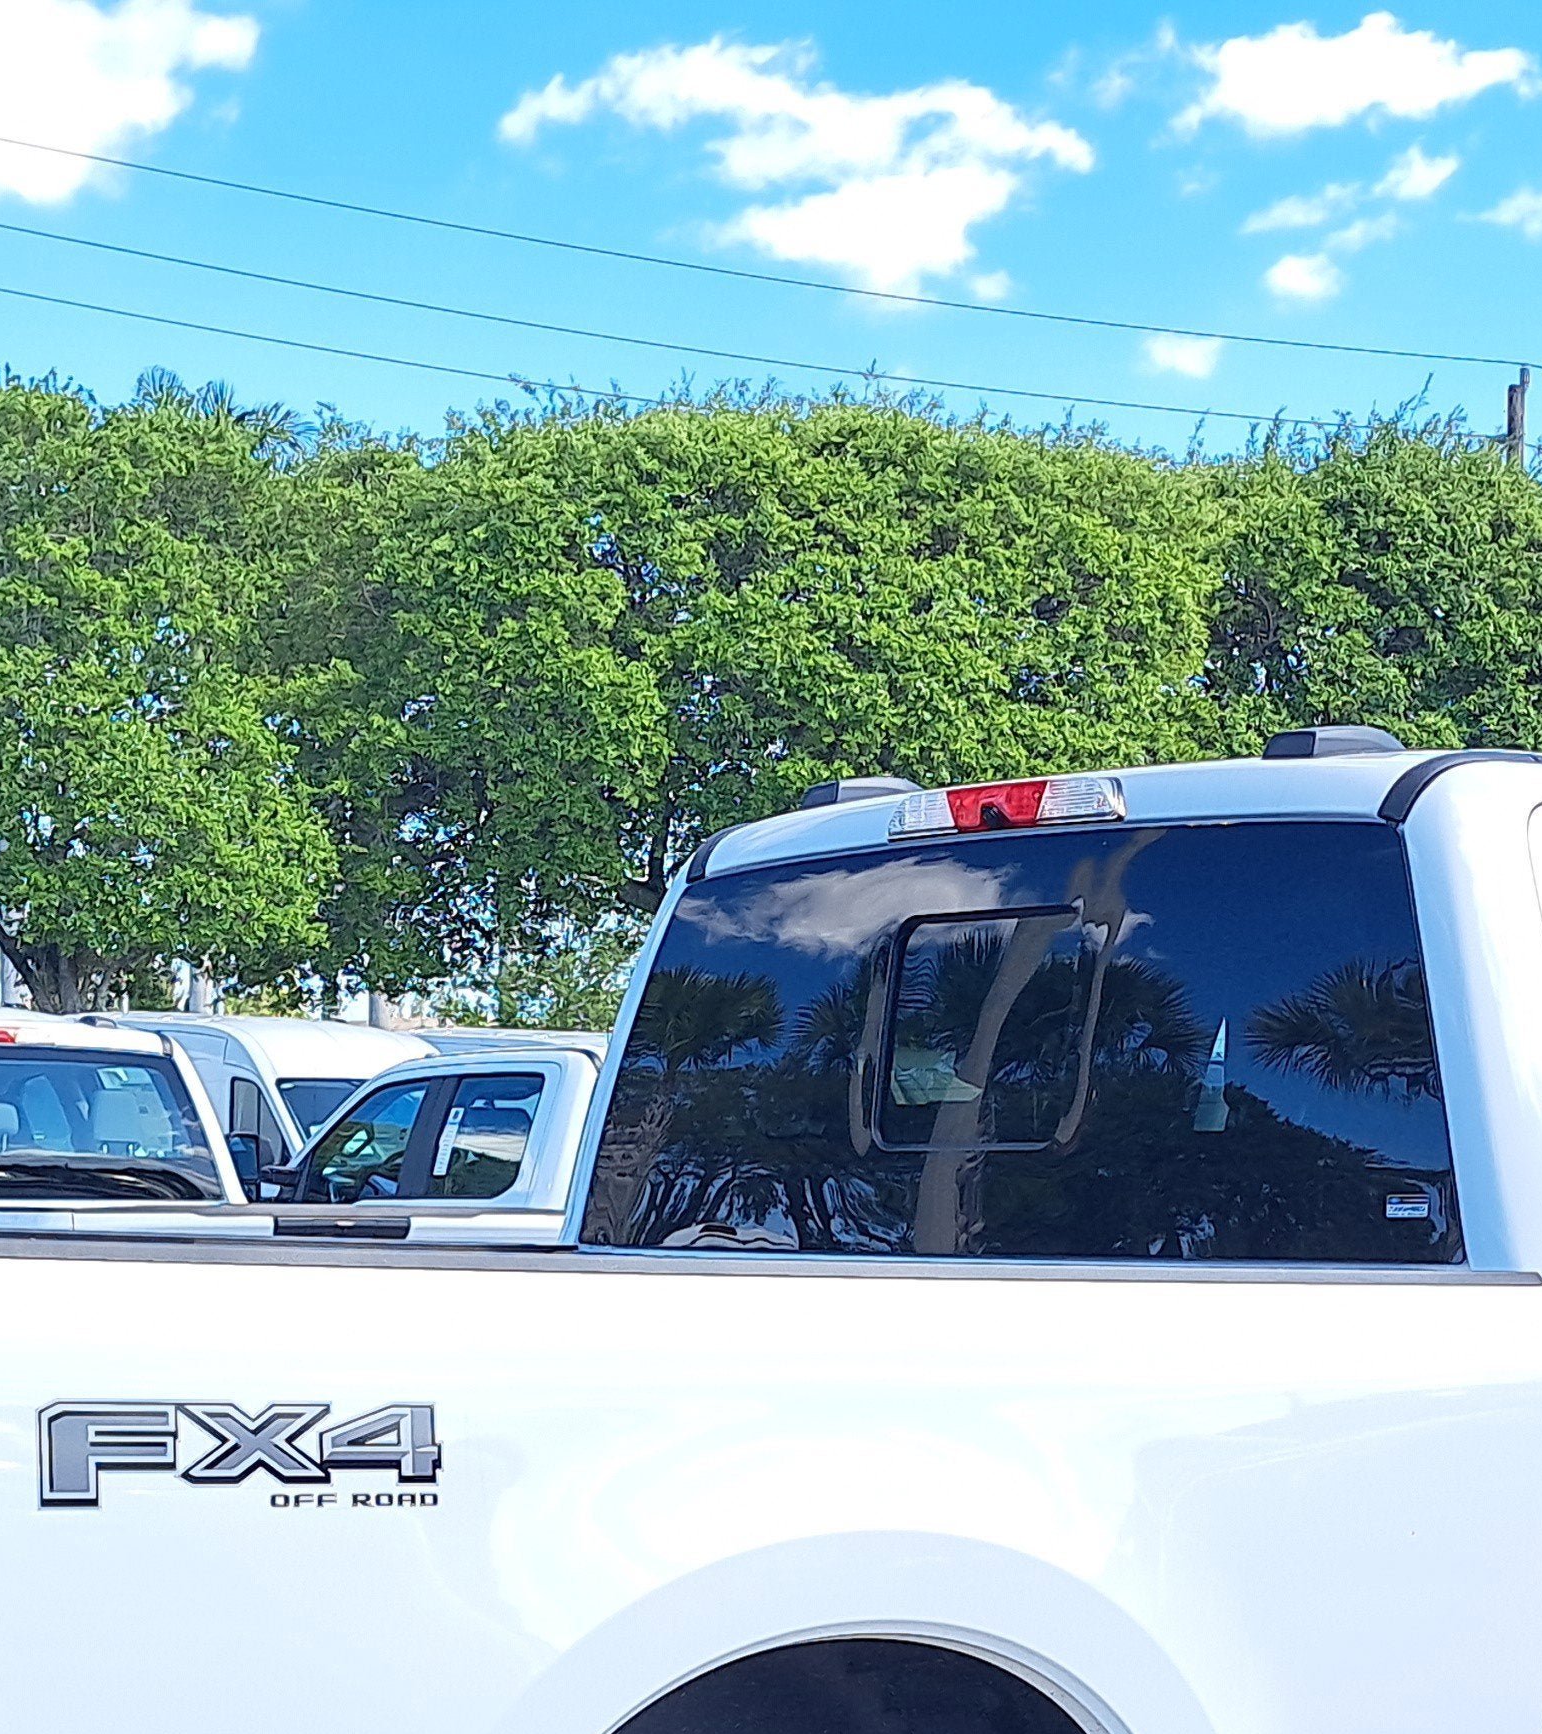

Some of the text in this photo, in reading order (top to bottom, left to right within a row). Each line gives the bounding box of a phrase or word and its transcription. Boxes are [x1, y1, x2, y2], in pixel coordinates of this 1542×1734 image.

[37, 1400, 441, 1508] FX4
[270, 1493, 440, 1508] OFF ROAD
